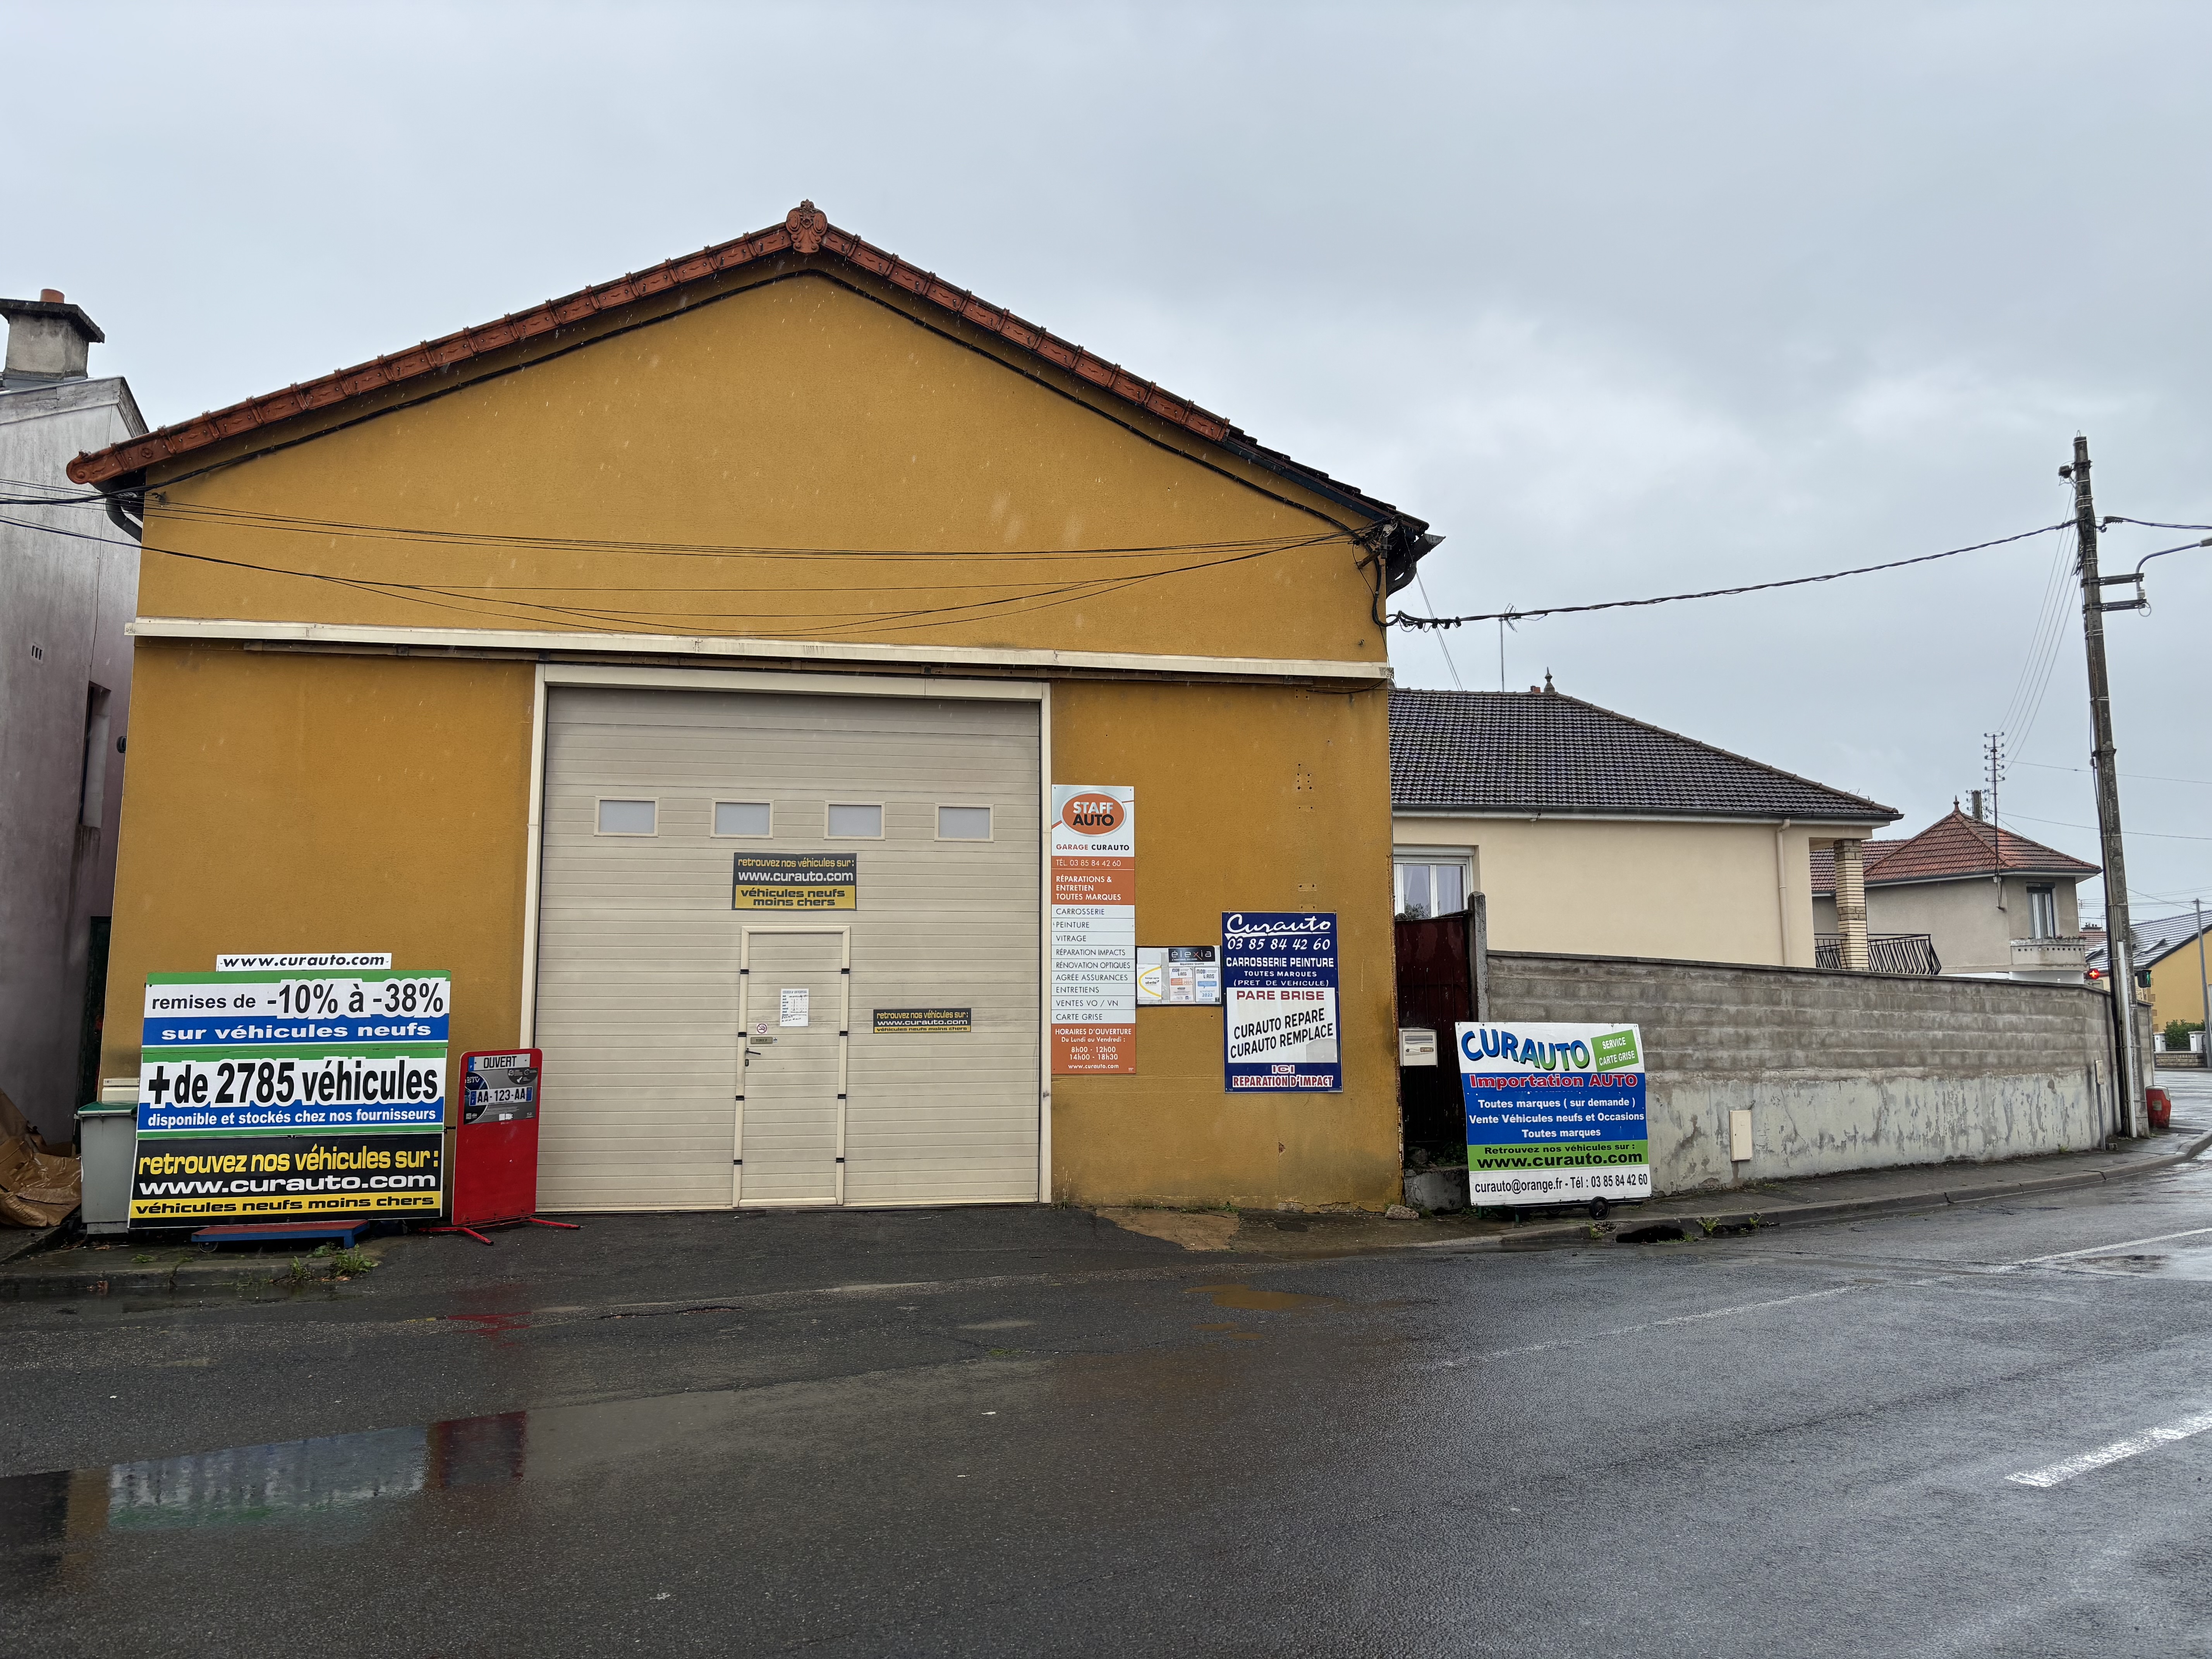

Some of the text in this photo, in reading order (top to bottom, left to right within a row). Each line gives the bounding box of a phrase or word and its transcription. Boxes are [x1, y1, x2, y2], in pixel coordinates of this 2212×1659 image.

[1073, 802, 1113, 814] STAFF
[1073, 814, 1114, 827] AUTO
[738, 858, 780, 867] retrouvez
[798, 857, 835, 867] véhicules
[738, 871, 853, 882] www.curauto.com
[1056, 874, 1104, 883] RÉPARATIONS
[741, 888, 845, 897] véhicules neufs
[753, 898, 835, 906] moins chers
[1226, 914, 1331, 933] Curauto
[1228, 938, 1330, 950] 03 85 84 42 60
[223, 955, 384, 967] www.curauto.com
[1226, 957, 1334, 967] CARROSSERIE PEINTURE
[152, 982, 443, 1014] remises de -10% à -38%
[1237, 991, 1324, 1000] PARE BRISE
[924, 1010, 953, 1018] véhicules
[1234, 1007, 1325, 1040] CURAUTO REPARE
[161, 1022, 431, 1040] sur véhicules neufs
[1231, 1023, 1334, 1058] CURAUTO REMPLACE
[1602, 1037, 1626, 1049] SERVICE
[1461, 1028, 1590, 1071] CURAUTO
[484, 1056, 517, 1068] OUVERT
[1599, 1050, 1635, 1066] CARTE GRISE
[1271, 1064, 1295, 1074] ICI
[216, 1062, 294, 1104] 2785
[302, 1060, 438, 1101] véhicules
[1233, 1075, 1334, 1087] REPARATION D'IMPACT
[1470, 1073, 1638, 1091] Importation AUTO
[1478, 1098, 1630, 1109] Toutes marques sur demande
[148, 1109, 436, 1128] disponible et stockés chez nos fournisseurs
[1469, 1115, 1499, 1123] Vente
[1502, 1114, 1553, 1123] Véhicules
[1556, 1114, 1583, 1122] neufs
[1597, 1112, 1644, 1121] Occasions
[1522, 1129, 1601, 1139] Toutes marques
[1565, 1144, 1612, 1152] véhicules
[139, 1144, 429, 1175] retrouvez nos véhicules sur
[1477, 1152, 1642, 1168] www.curauto.com
[139, 1175, 436, 1194] www.curauto.com
[1475, 1174, 1648, 1194] curauto@orange.fr Tél 03 85 84 42 60
[136, 1195, 434, 1215] véhicules neufs moins chers
